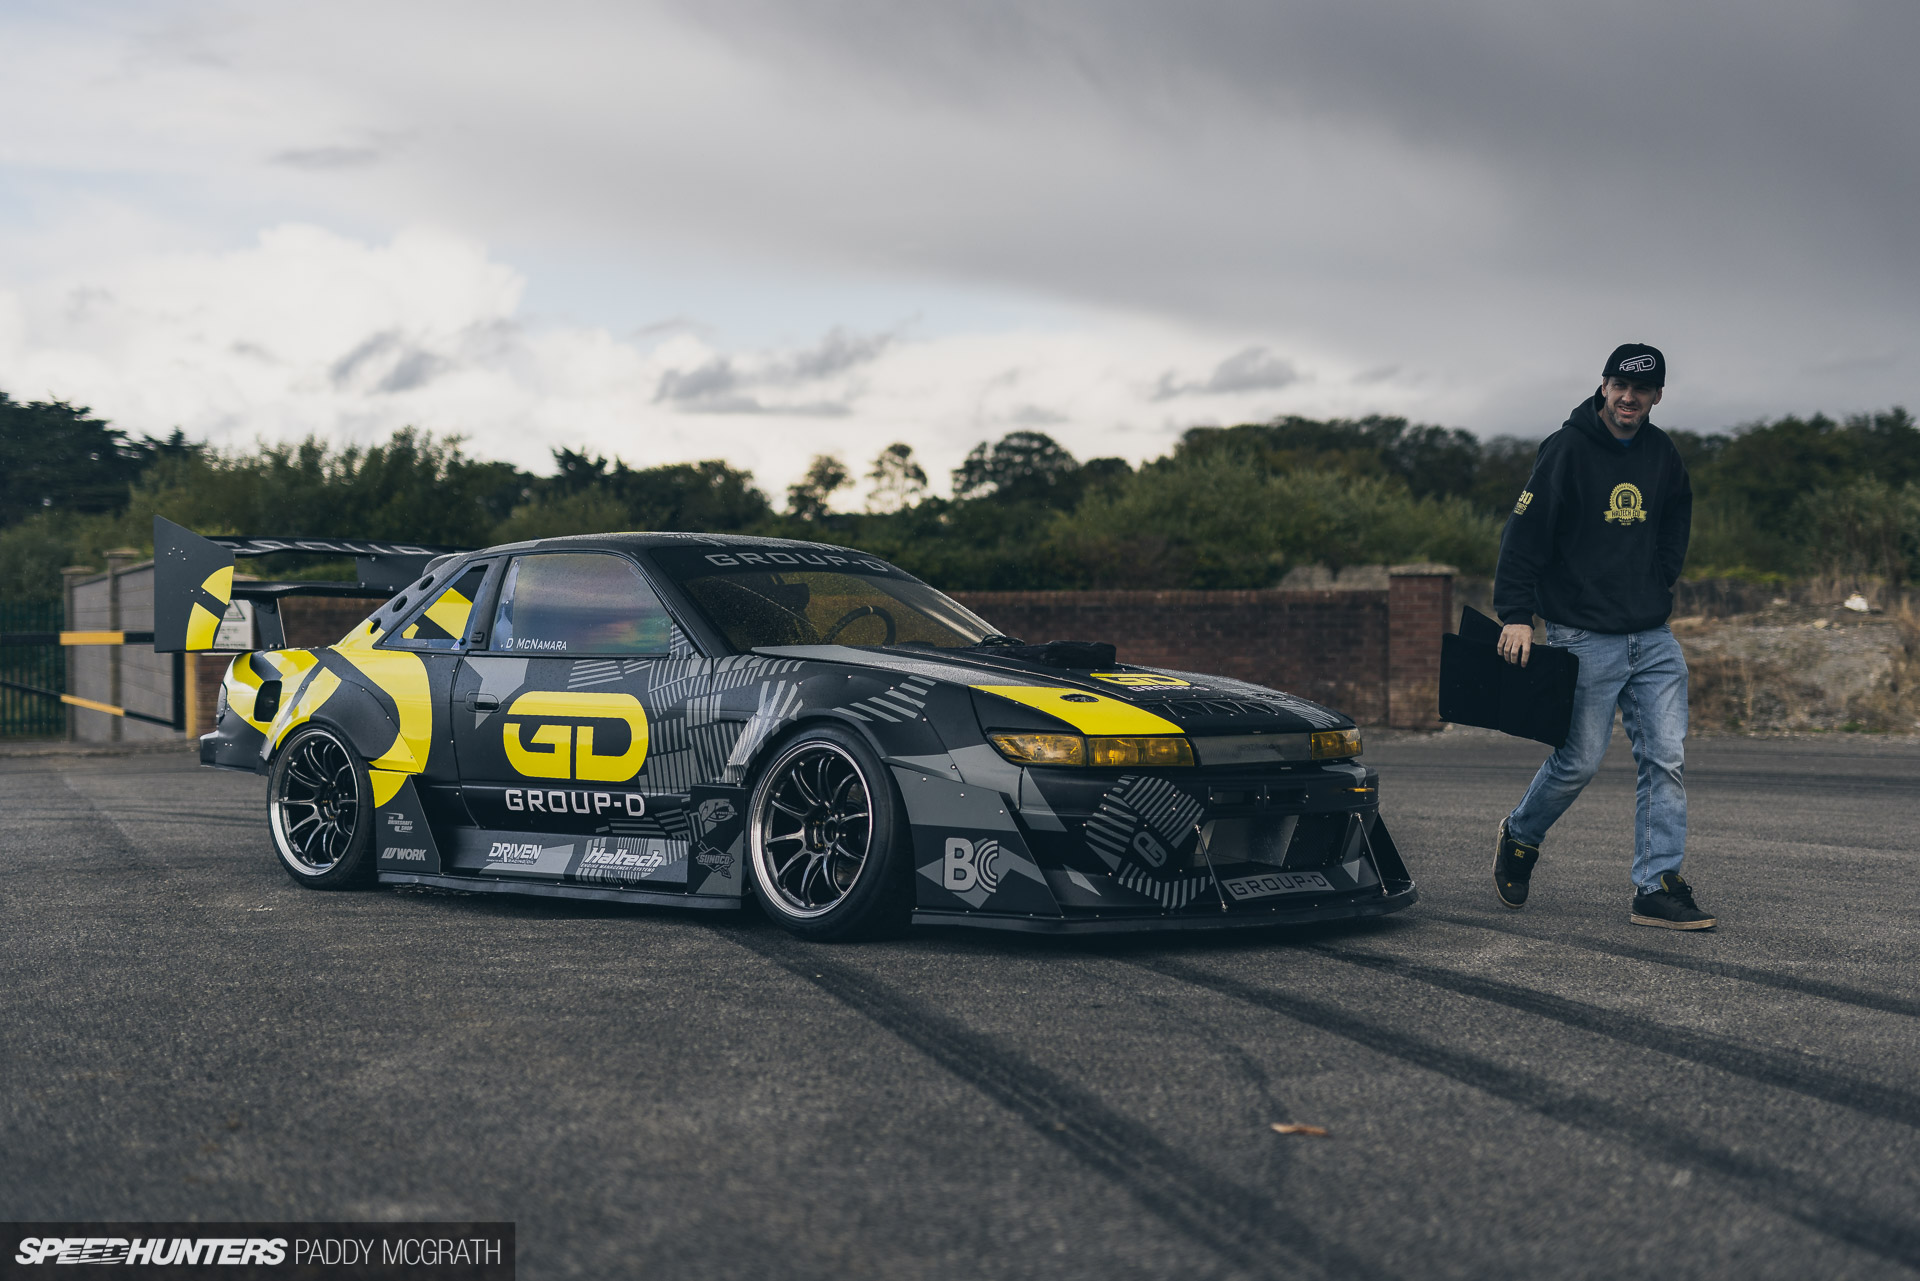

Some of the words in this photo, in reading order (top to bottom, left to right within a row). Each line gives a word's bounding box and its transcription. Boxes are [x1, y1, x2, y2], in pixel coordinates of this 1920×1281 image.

[704, 552, 889, 572] GROUP-D
[503, 690, 649, 782] GD
[505, 789, 645, 817] GROUP-D
[396, 847, 427, 861] WORK
[488, 842, 543, 863] DRIVEN
[584, 847, 664, 869] Haltech
[699, 854, 731, 865] SUNOCO
[1228, 874, 1328, 896] GROUP-D
